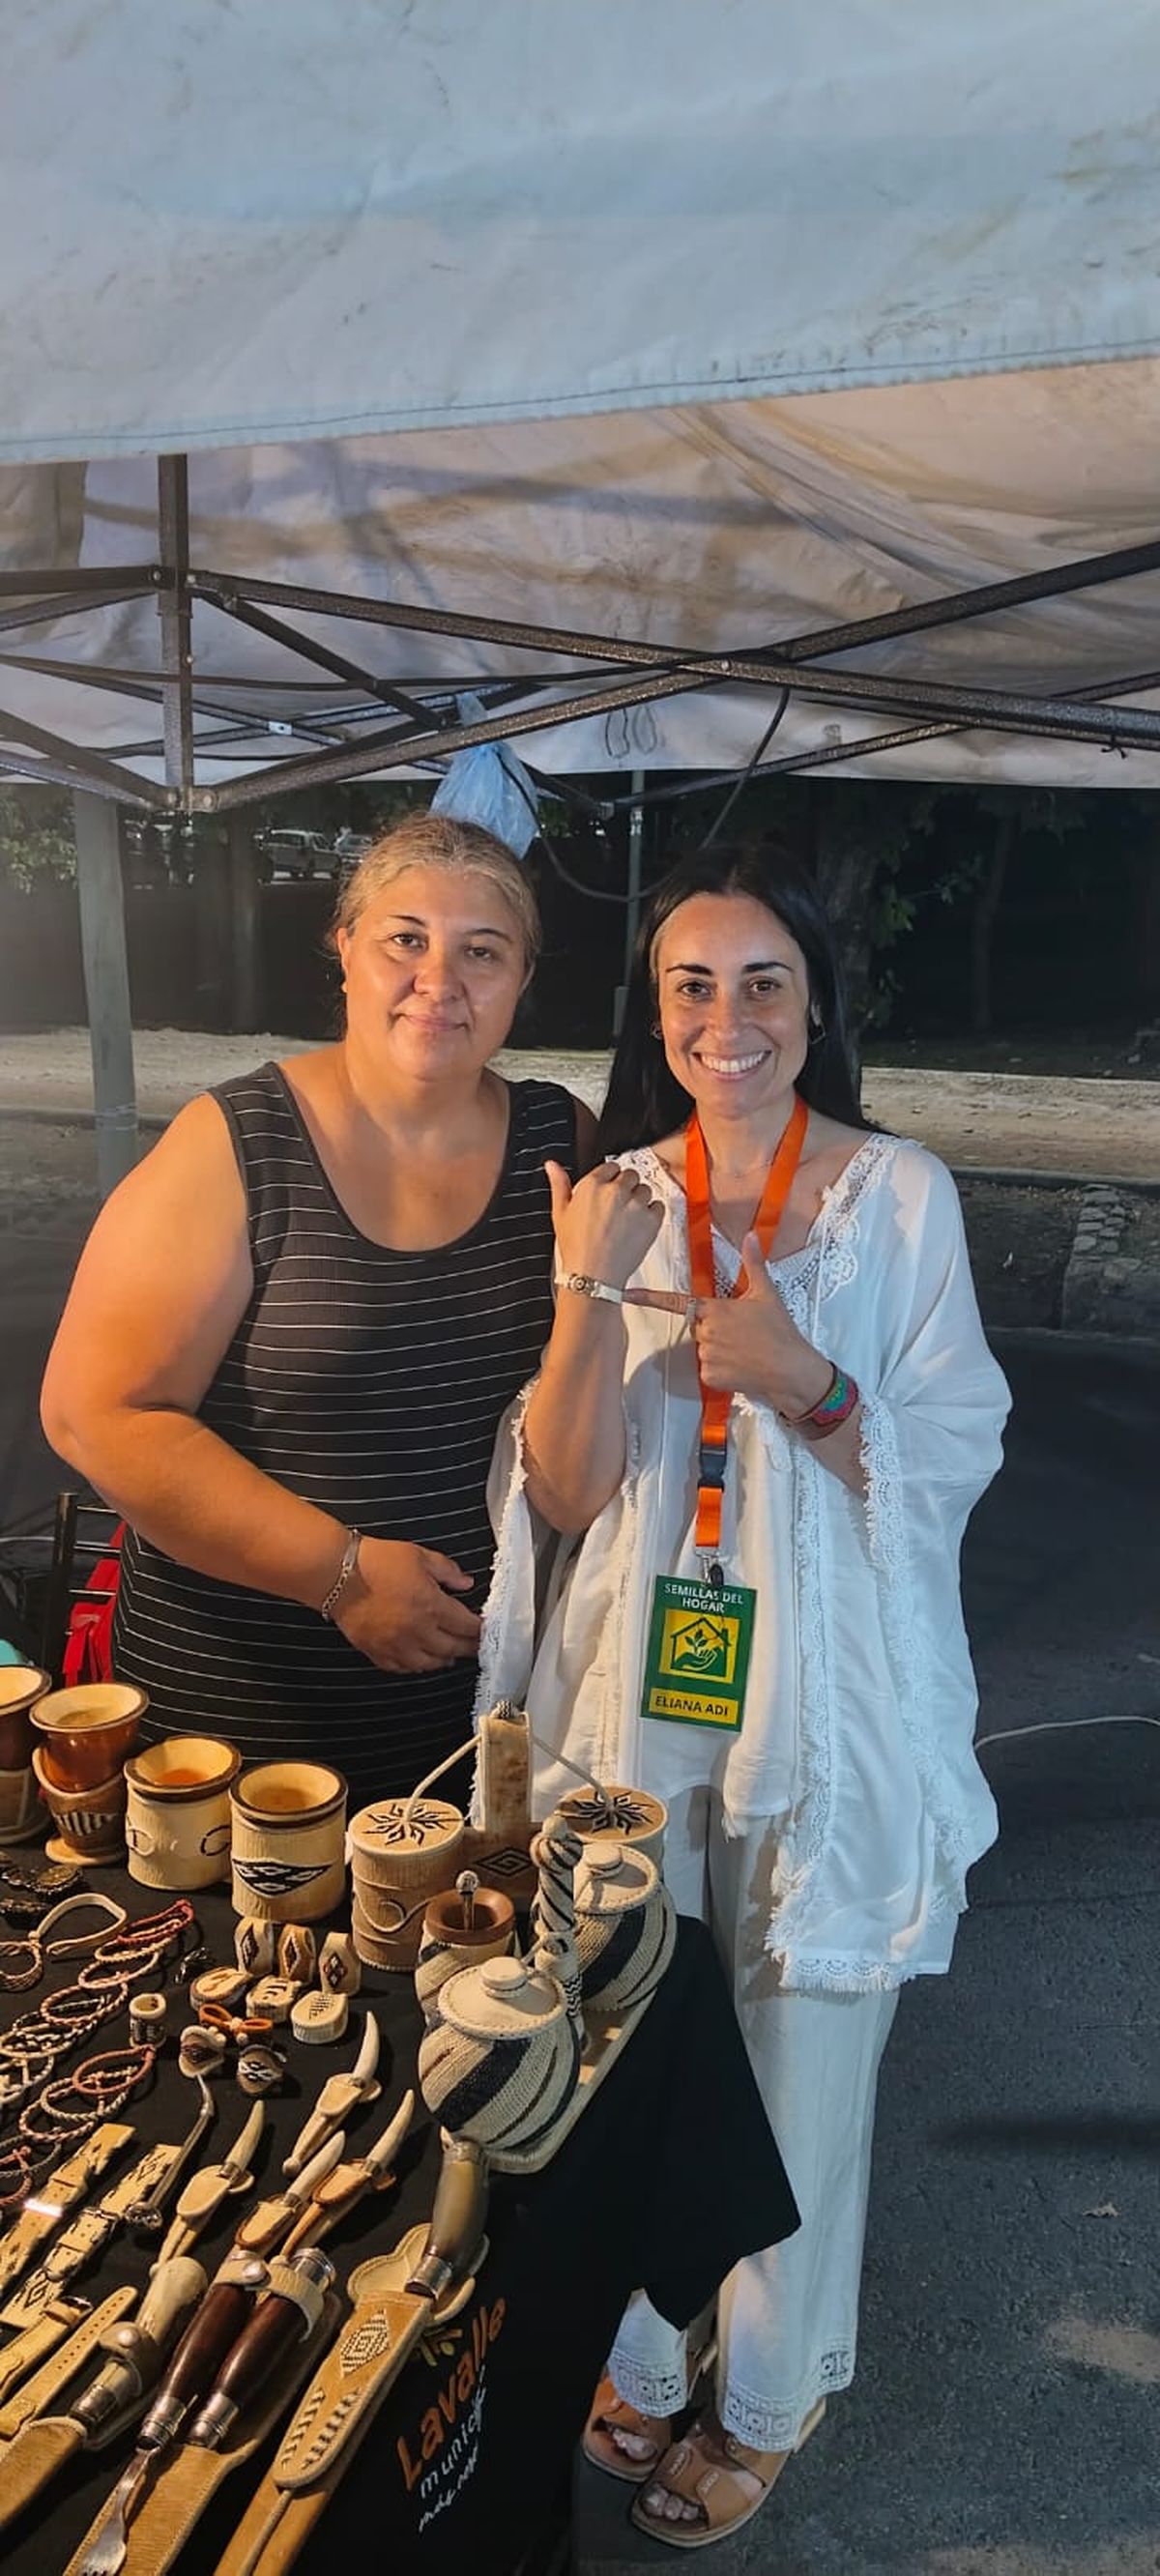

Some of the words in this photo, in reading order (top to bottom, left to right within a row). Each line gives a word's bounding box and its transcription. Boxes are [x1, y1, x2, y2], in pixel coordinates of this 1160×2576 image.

[664, 1583, 719, 1601] SEMILLAS
[722, 1592, 743, 1605] DEL
[682, 1597, 725, 1613] HOGAR
[655, 1695, 702, 1714] ELIANA
[706, 1704, 728, 1716] ADI
[397, 2298, 506, 2491] Lavalle
